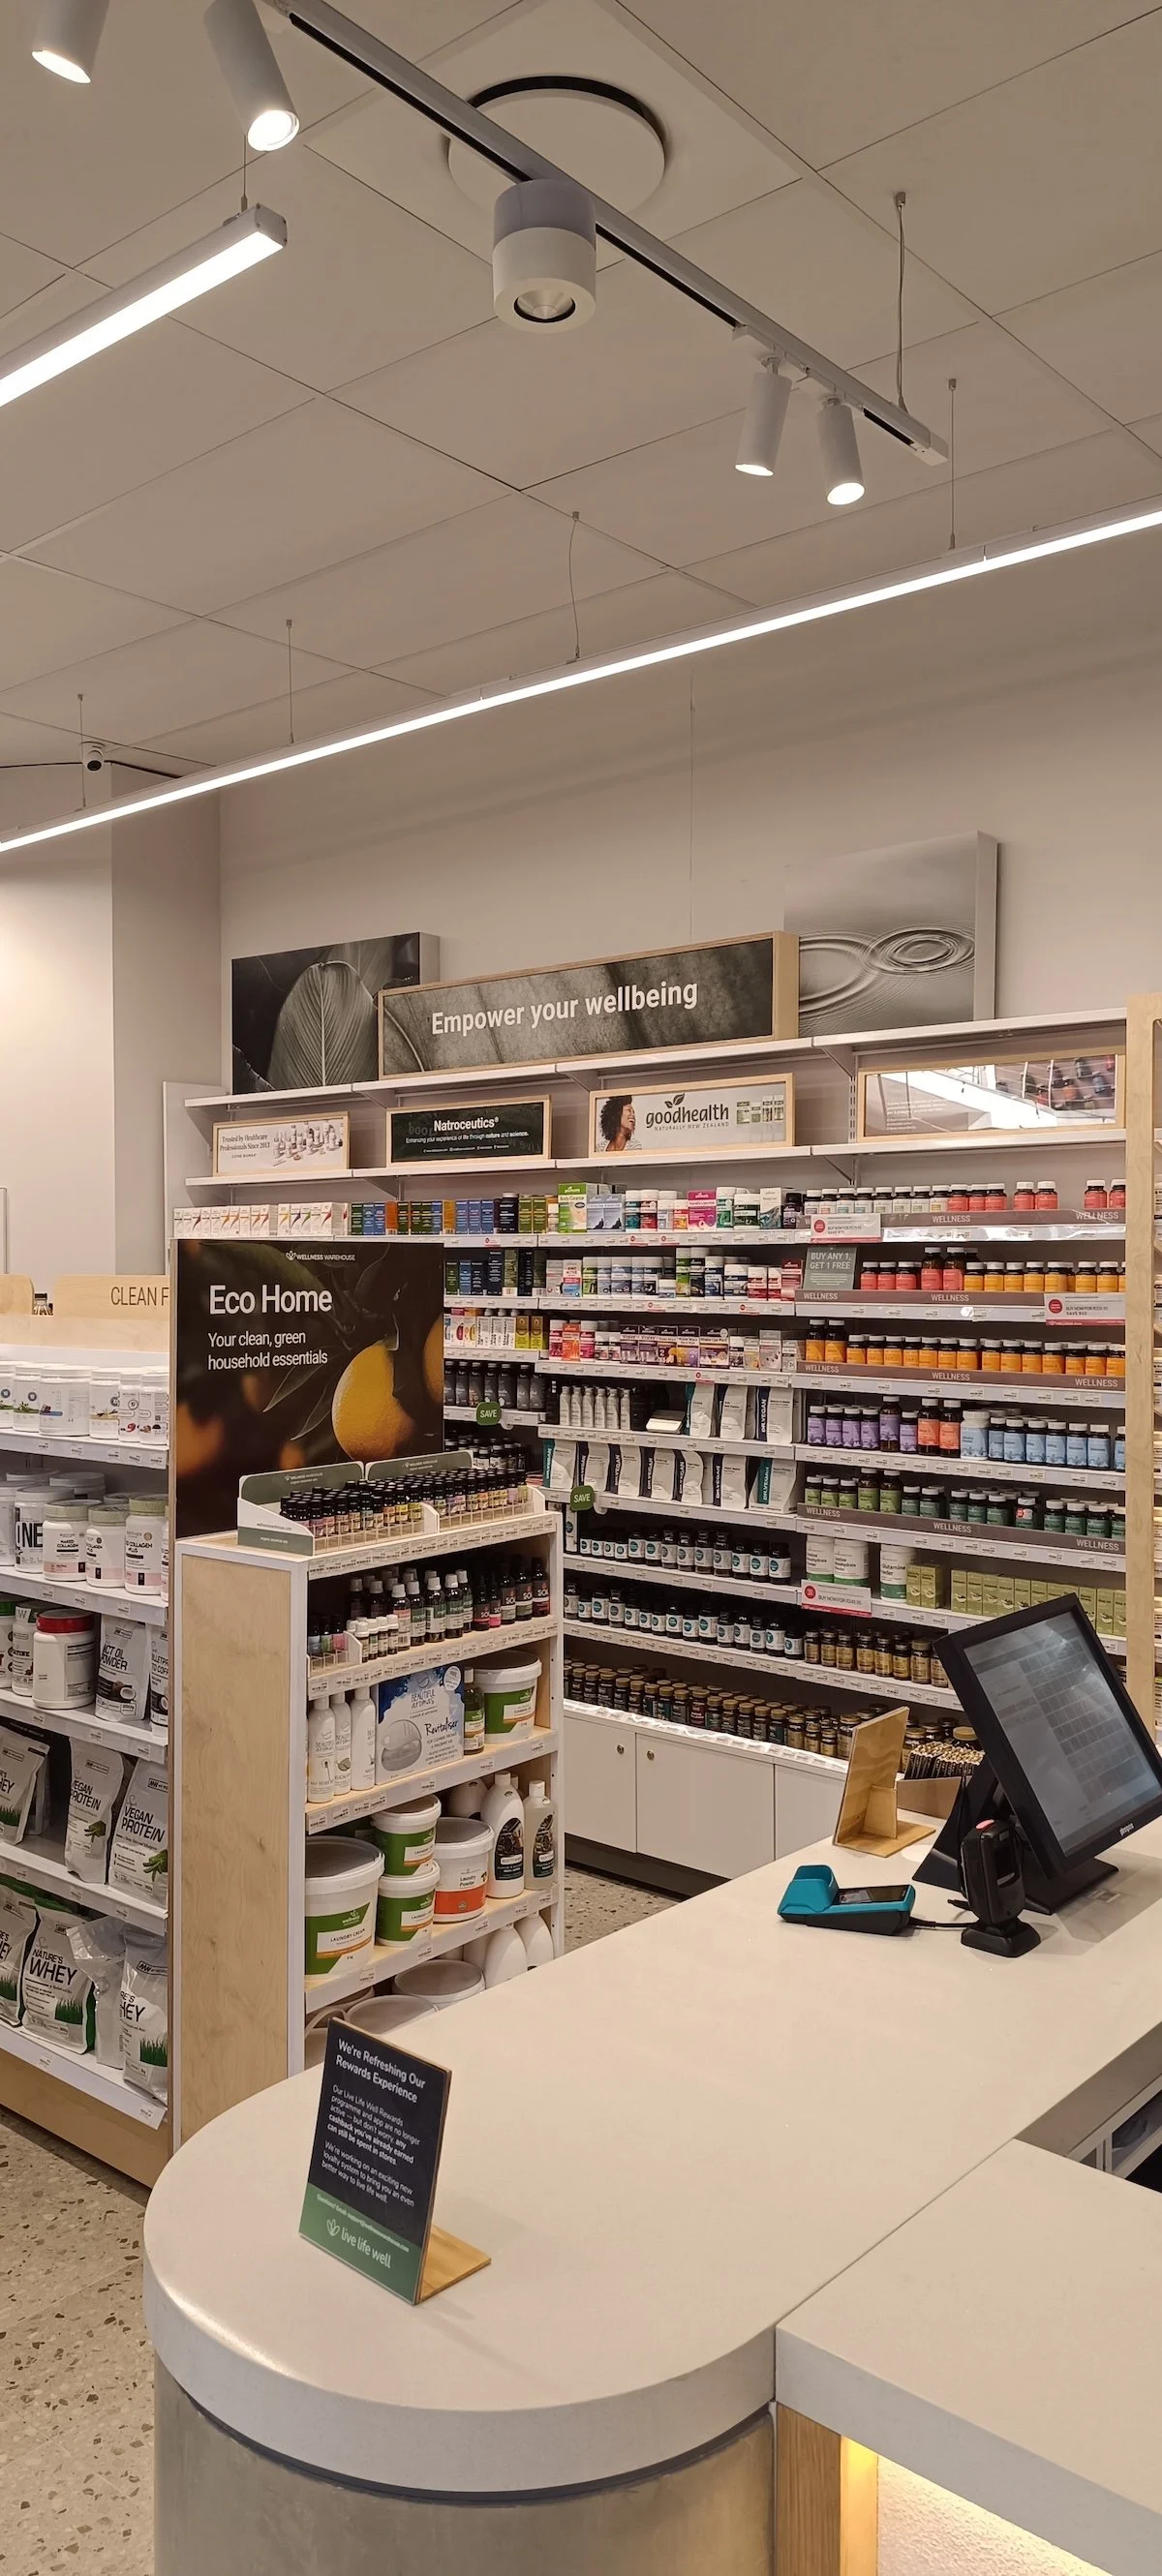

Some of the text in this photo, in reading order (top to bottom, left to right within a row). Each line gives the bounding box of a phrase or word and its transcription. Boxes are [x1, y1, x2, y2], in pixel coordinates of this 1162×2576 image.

[432, 981, 697, 1036] Empower your wellbeing
[646, 1104, 729, 1128] goodhealth
[1076, 1211, 1118, 1220] WELLNESS
[110, 1287, 157, 1306] CLEAN
[209, 1284, 332, 1314] Eco Home
[208, 1331, 306, 1348] Your clean, green
[208, 1349, 327, 1370] household essentials
[932, 1372, 969, 1380] WELLNESS
[1075, 1379, 1117, 1387] WELLNESS
[480, 1409, 497, 1418] SAVE
[574, 1494, 591, 1502] SAVE
[806, 1507, 841, 1517] WELLNESS
[933, 1522, 971, 1533] WELLNESS
[1076, 1538, 1119, 1551] WELLNESS
[125, 1805, 153, 1824] VEGAN
[121, 1817, 165, 1842] PROTEIN
[33, 1949, 63, 1964] NATURE'S
[30, 1957, 77, 1985] WHEY
[339, 2038, 425, 2088] We're Refreshing Our
[336, 2054, 417, 2103] Rewards Experience
[333, 2084, 403, 2126] Our Live Life Well Rewards
[330, 2105, 345, 2117] active
[353, 2115, 362, 2126] but
[363, 2122, 377, 2134] don't
[396, 2139, 407, 2150] any
[331, 2096, 361, 2115] programme
[362, 2110, 372, 2120] and
[373, 2116, 383, 2127] app
[384, 2123, 393, 2132] are
[402, 2131, 420, 2145] longer
[327, 2124, 337, 2133] can
[338, 2130, 348, 2138] still
[349, 2134, 355, 2142] be
[356, 2139, 372, 2151] spent
[373, 2146, 378, 2155] in
[329, 2114, 413, 2164] cashback you've already earned
[322, 2160, 337, 2173] better
[338, 2170, 349, 2181] way
[356, 2179, 365, 2191] live
[366, 2185, 375, 2196] life
[323, 2150, 340, 2166] loyalty
[341, 2162, 359, 2176] system
[360, 2171, 366, 2180] to
[366, 2174, 381, 2190] bring
[382, 2185, 392, 2195] you
[400, 2195, 414, 2207] even
[325, 2140, 340, 2155] We're
[341, 2151, 362, 2168] working
[371, 2167, 378, 2176] an
[379, 2171, 399, 2190] exciting
[400, 2184, 413, 2195] new
[342, 2227, 391, 2268] live life well
